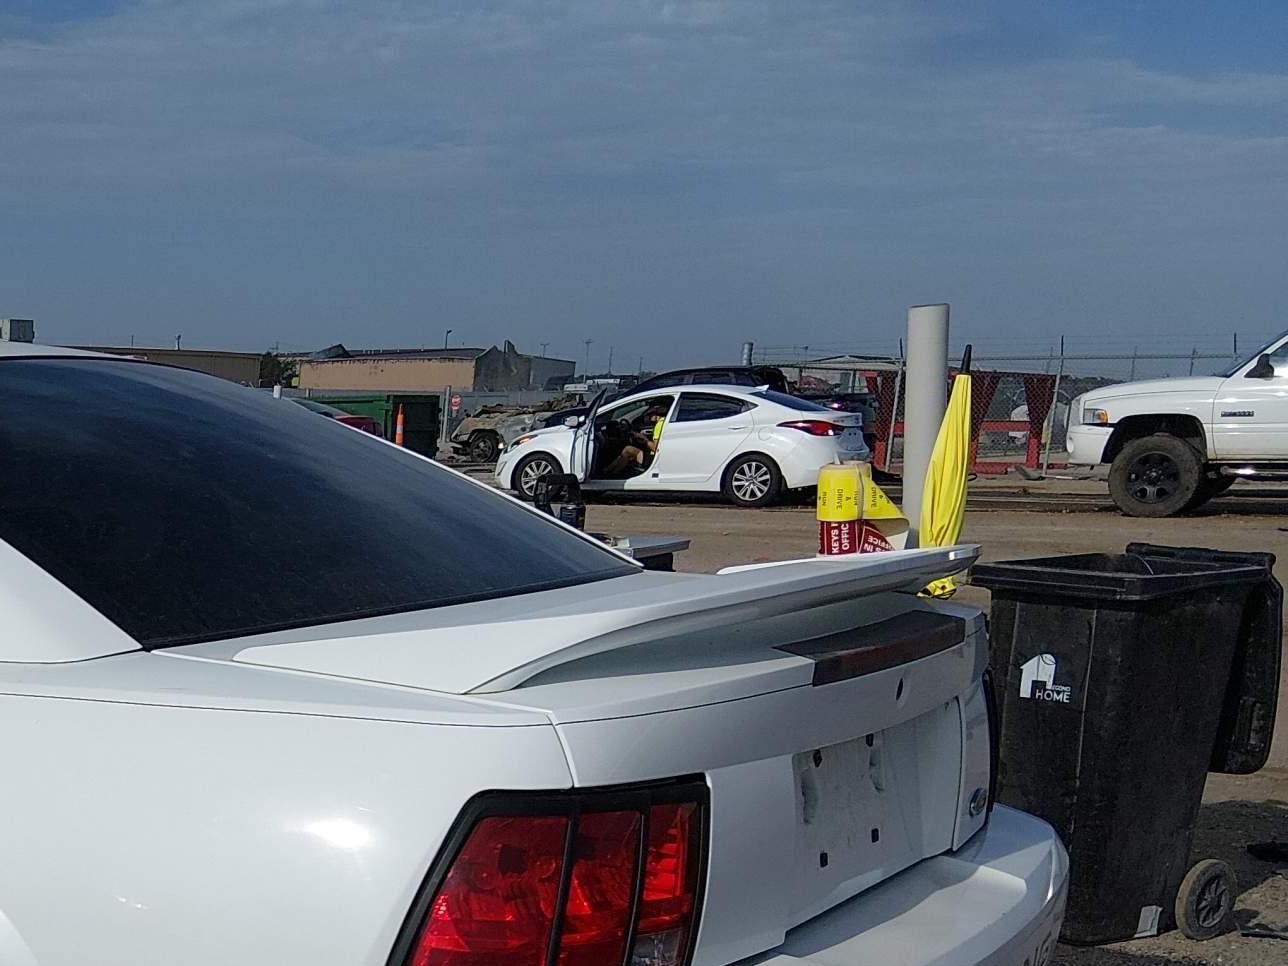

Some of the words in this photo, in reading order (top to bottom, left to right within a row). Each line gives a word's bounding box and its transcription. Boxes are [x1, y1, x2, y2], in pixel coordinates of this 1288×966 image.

[831, 529, 839, 554] KEYS
[841, 523, 850, 550] OFFIC
[1036, 689, 1071, 703] HOME
